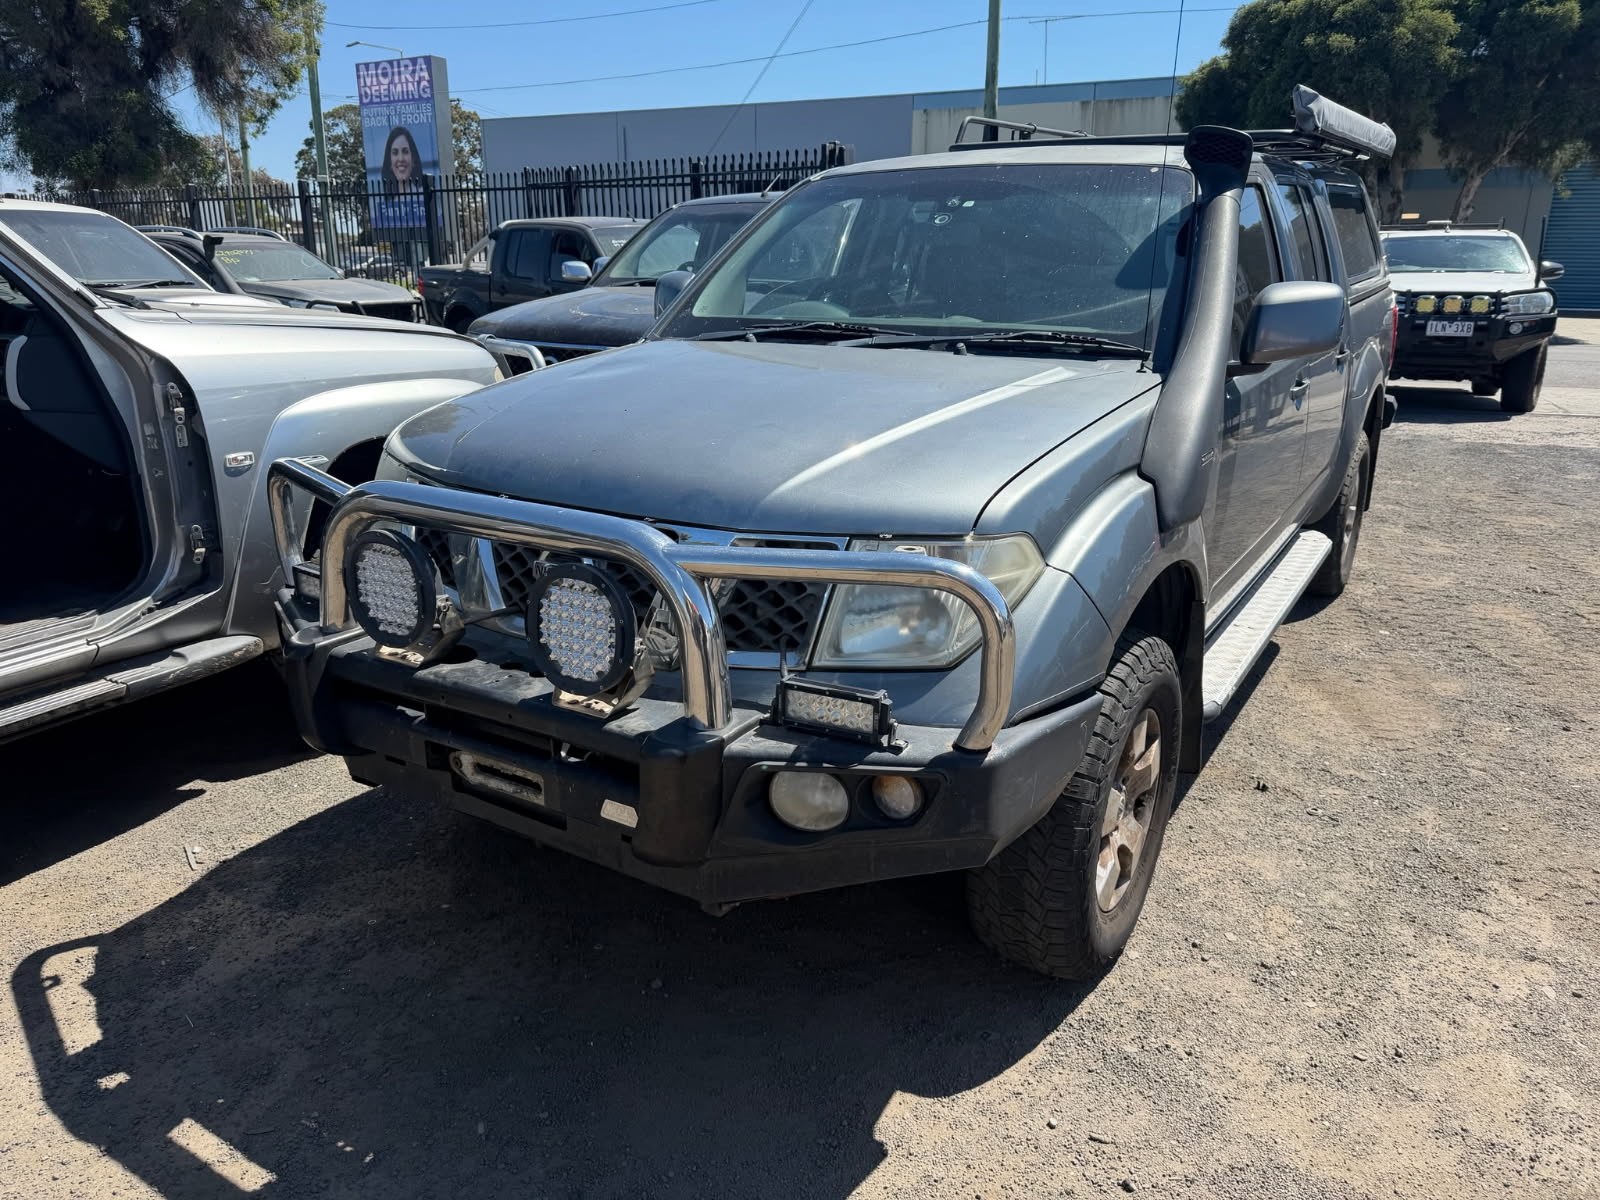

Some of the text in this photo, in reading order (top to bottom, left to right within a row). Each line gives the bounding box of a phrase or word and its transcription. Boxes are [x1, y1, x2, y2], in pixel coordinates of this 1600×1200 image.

[359, 58, 430, 87] MOIRA
[361, 80, 431, 103] DEEMING
[364, 103, 432, 118] PUTTING FAMILIES
[364, 112, 432, 128] BACK IN FRONT
